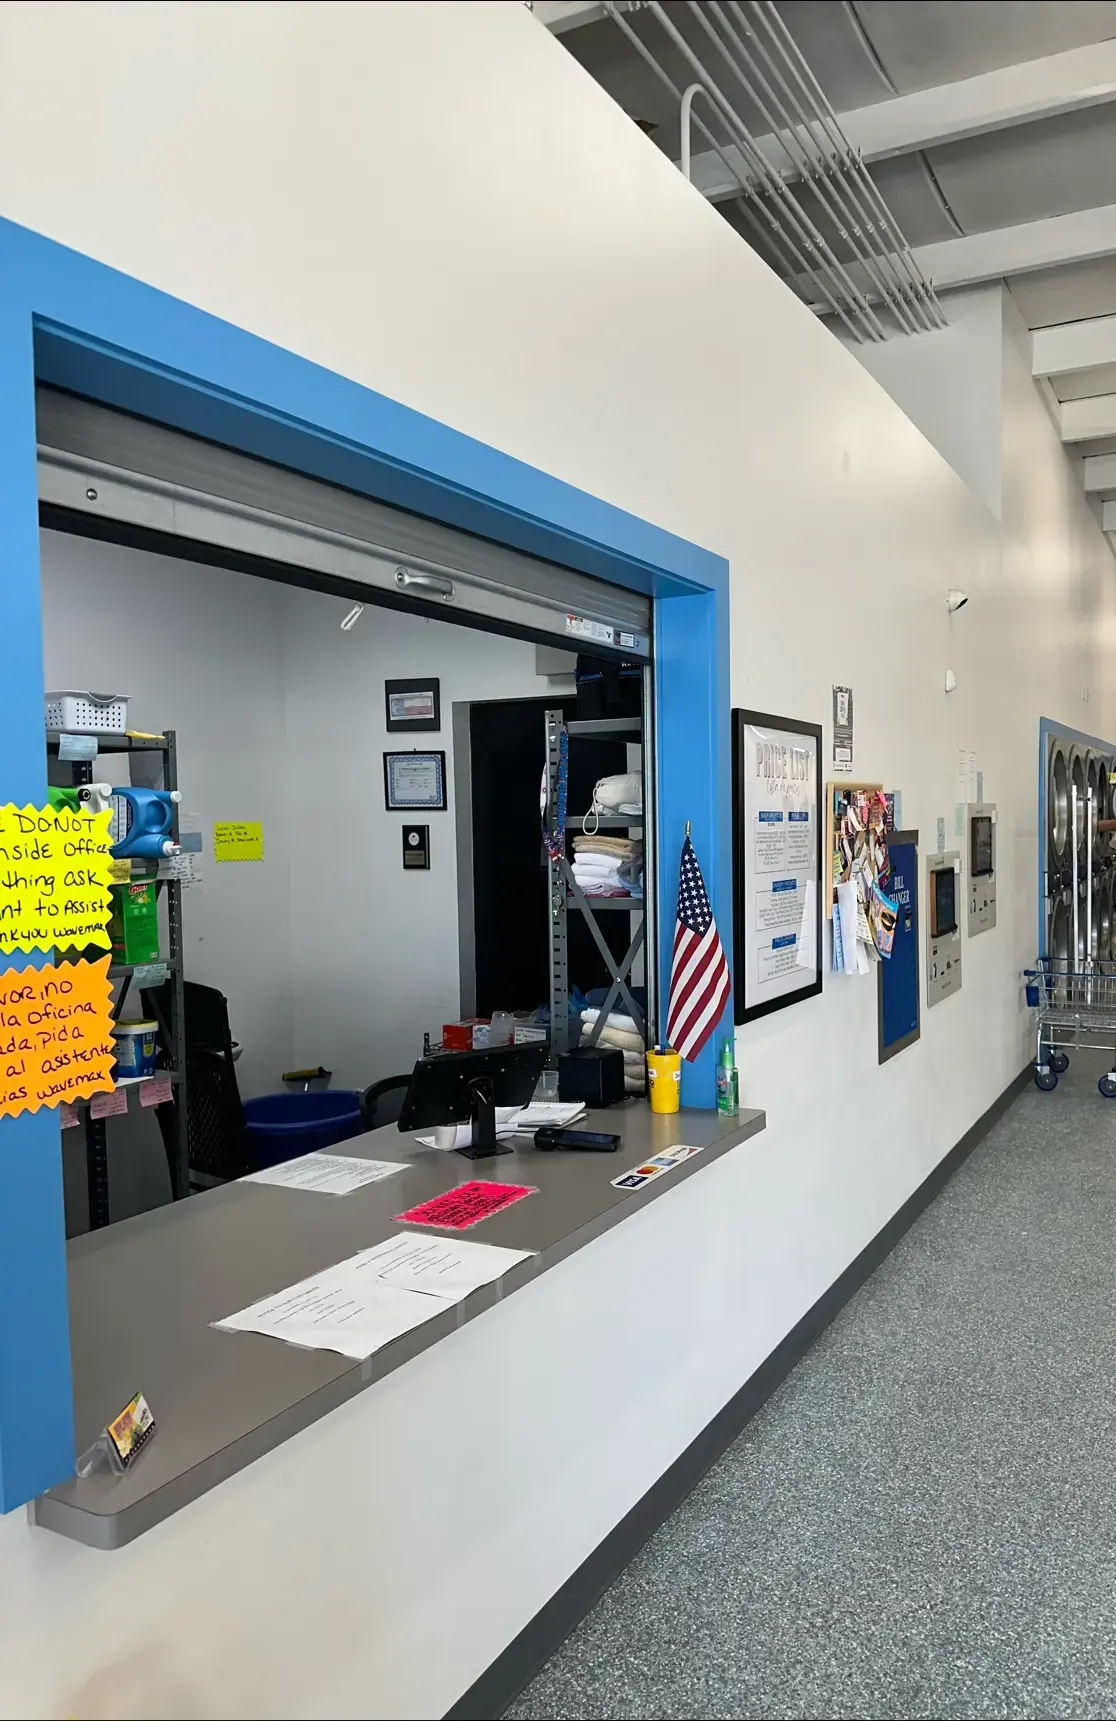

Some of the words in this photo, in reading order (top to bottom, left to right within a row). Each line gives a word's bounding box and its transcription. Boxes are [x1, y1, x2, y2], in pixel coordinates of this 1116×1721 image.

[755, 743, 787, 779] PRICE
[790, 748, 810, 781] LIST
[64, 869, 104, 887] ask
[894, 876, 904, 890] BILL
[889, 890, 910, 905] CHANGER
[35, 898, 59, 916] to
[64, 899, 104, 916] Assist
[1, 1013, 21, 1027] la
[7, 1060, 26, 1077] al
